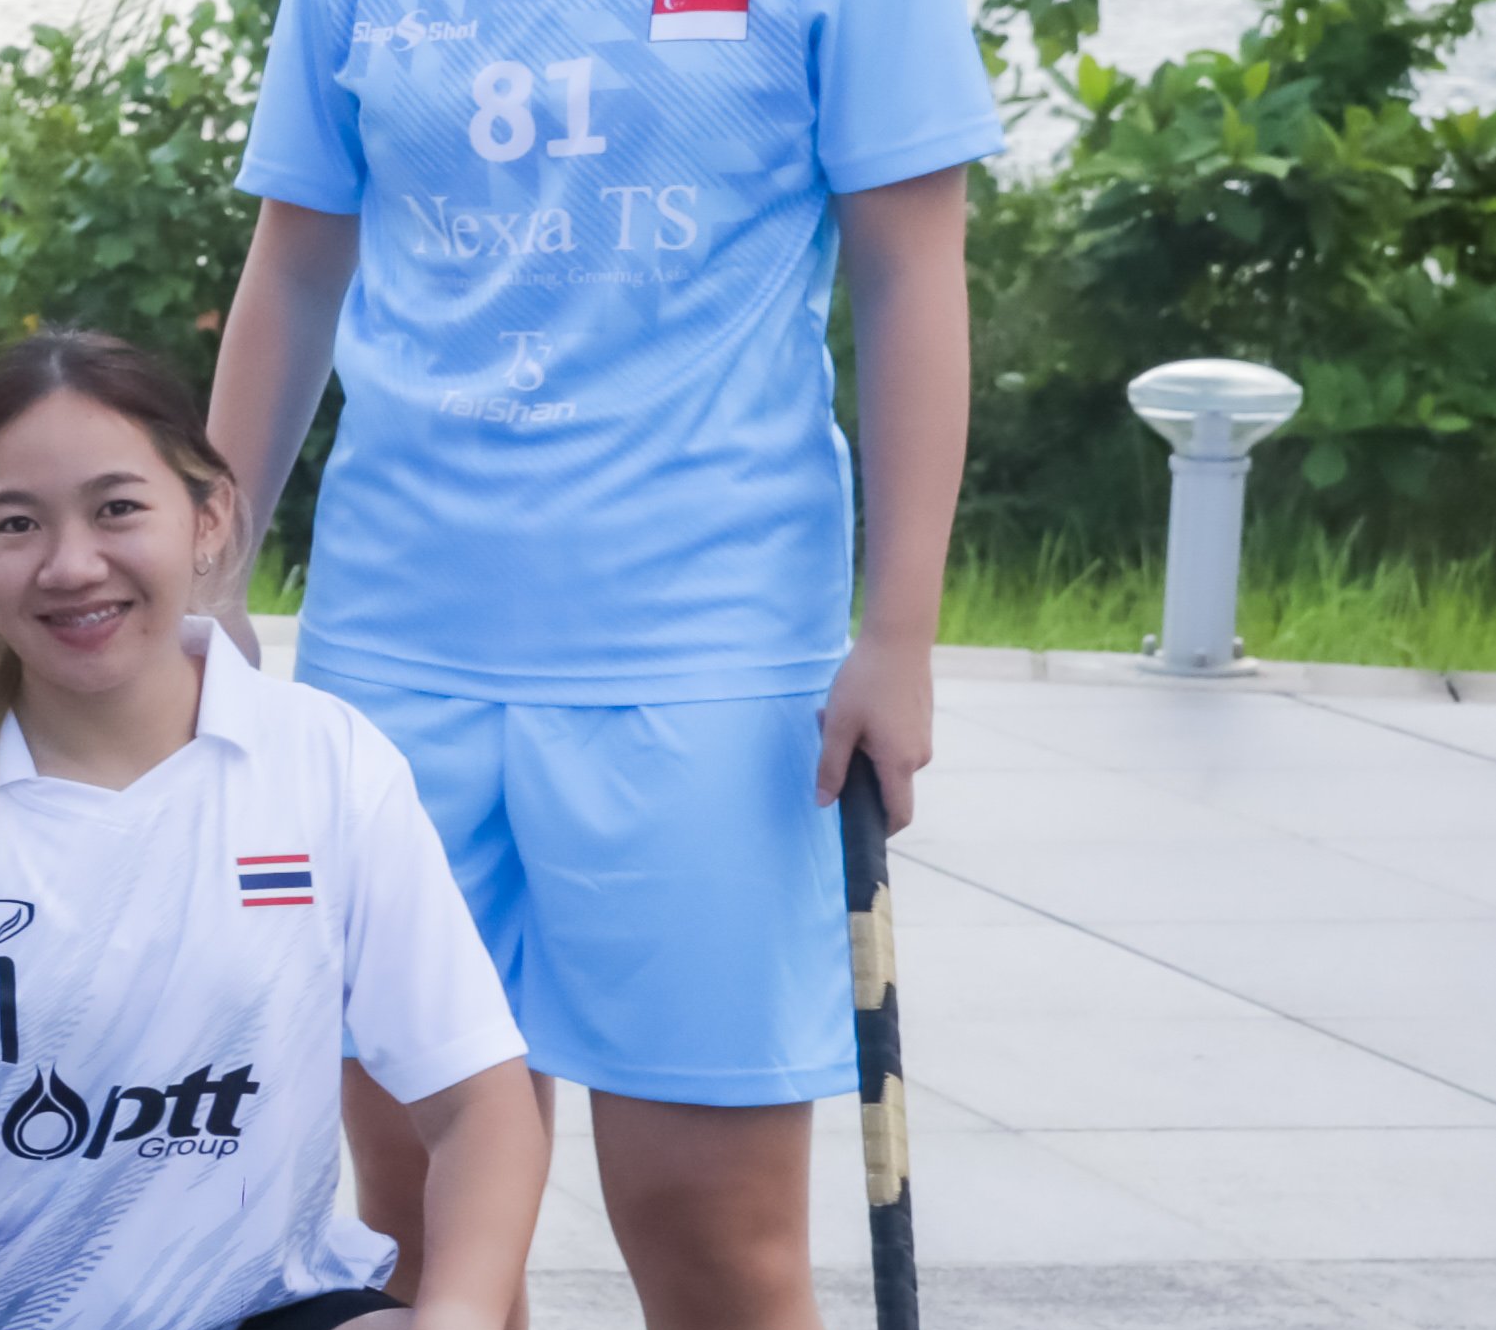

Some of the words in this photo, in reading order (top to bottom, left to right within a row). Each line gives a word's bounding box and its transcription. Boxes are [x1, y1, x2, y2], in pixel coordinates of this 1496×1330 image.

[468, 57, 607, 163] 81
[402, 193, 579, 259] Nexia
[599, 184, 699, 251] TS
[81, 1062, 261, 1160] ptt
[137, 1136, 240, 1160] Group
